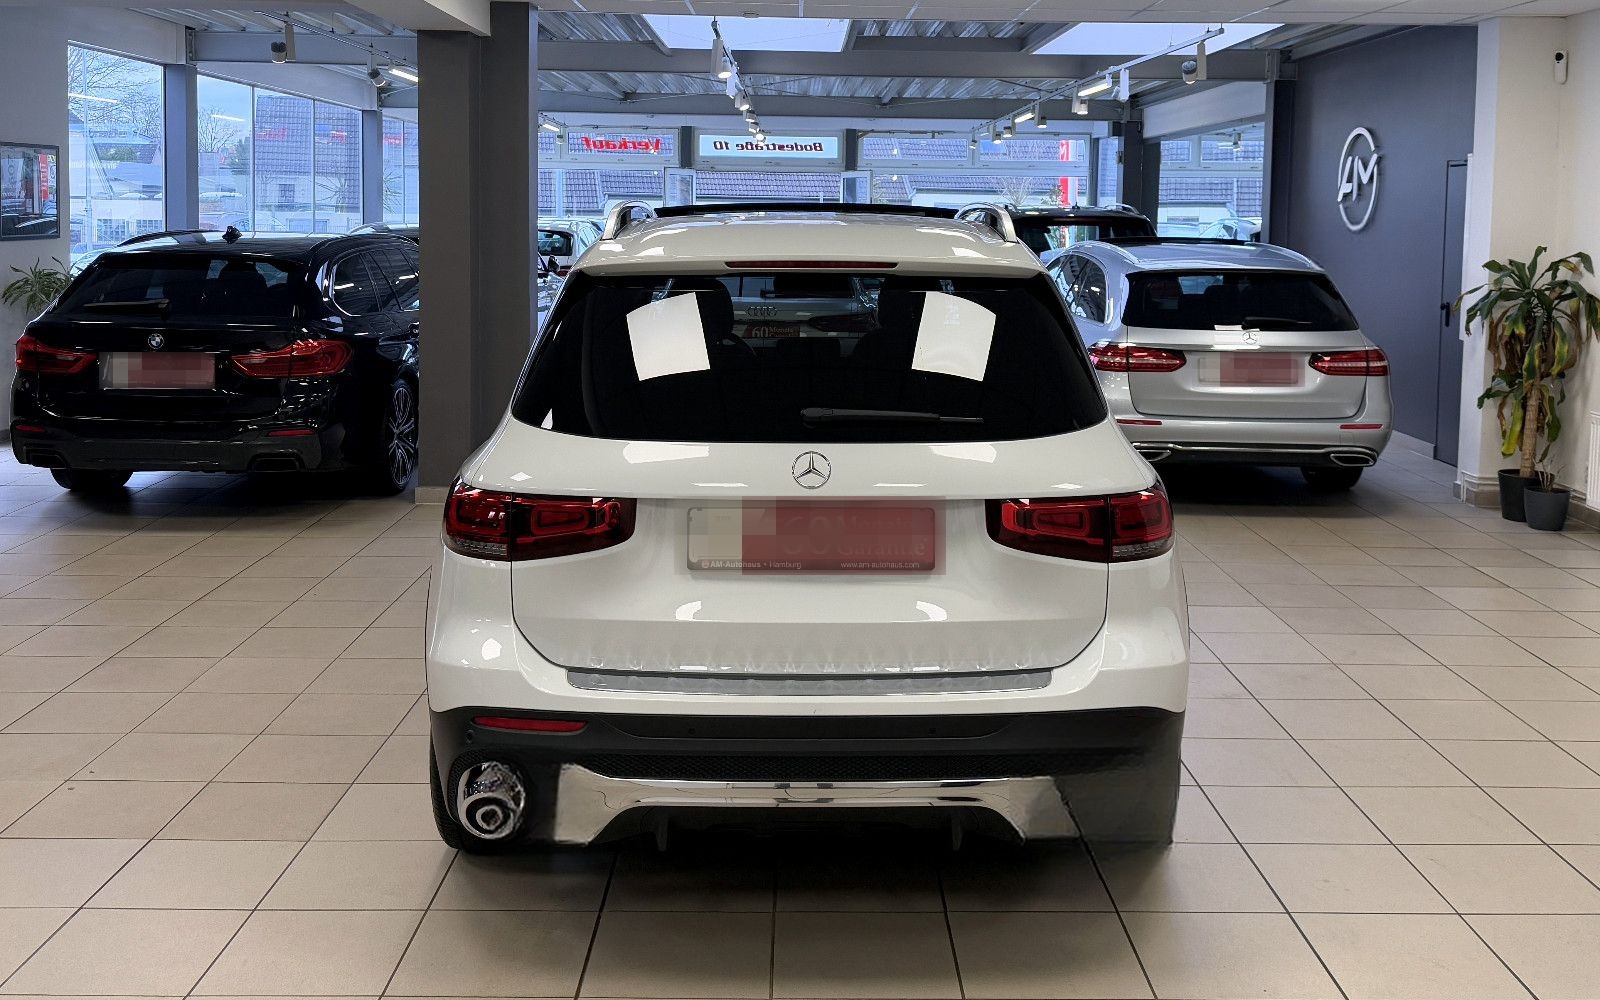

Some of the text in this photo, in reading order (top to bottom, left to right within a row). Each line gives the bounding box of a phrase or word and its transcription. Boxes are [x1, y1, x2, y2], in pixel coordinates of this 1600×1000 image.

[710, 560, 762, 569] AM-Autohaus
[769, 561, 802, 570] Hamburg
[840, 561, 920, 569] www.am-autohaus.com
